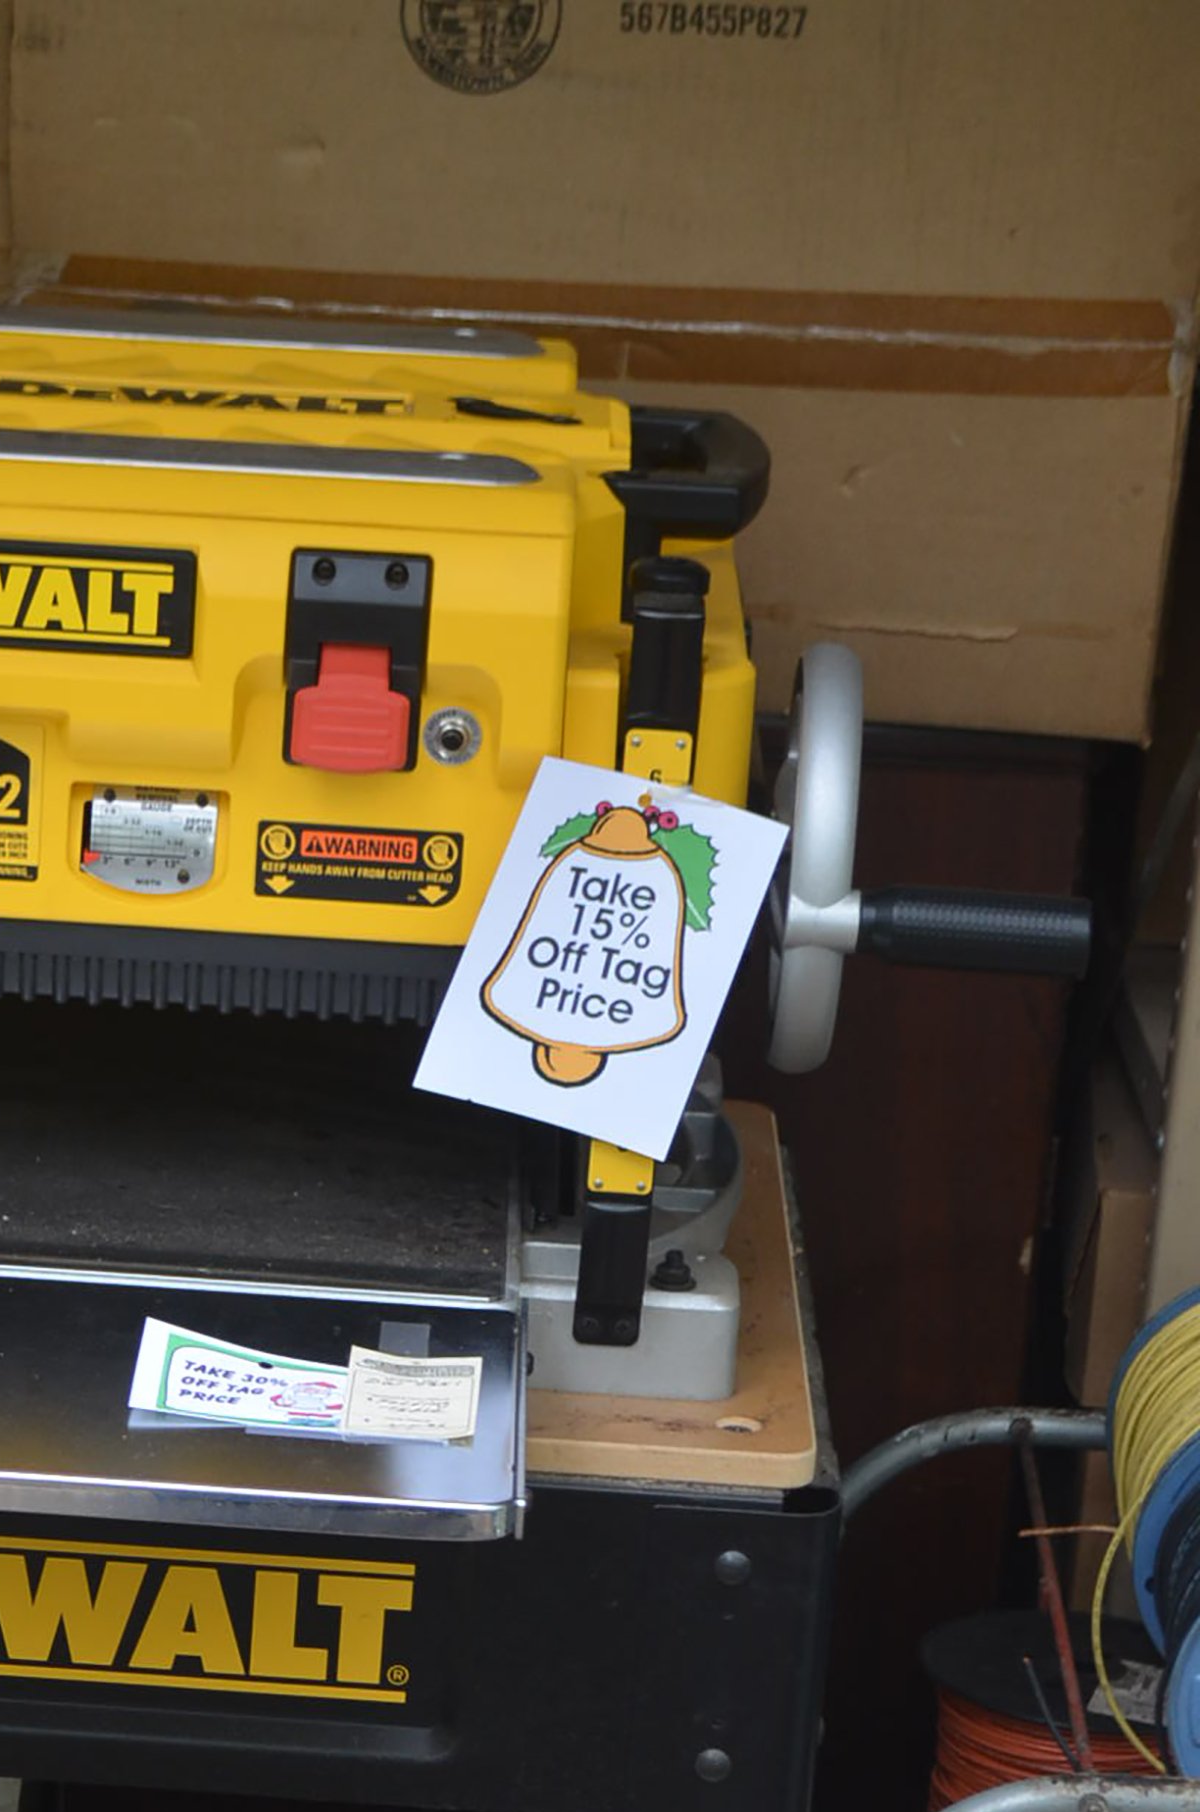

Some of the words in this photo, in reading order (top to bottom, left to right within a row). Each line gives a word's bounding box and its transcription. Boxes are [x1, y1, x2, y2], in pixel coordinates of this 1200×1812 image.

[323, 836, 414, 860] WARNING
[261, 861, 288, 873] KEEP
[288, 863, 324, 876] HANDS
[324, 865, 356, 878] AWAY
[357, 867, 386, 880] FROM
[386, 870, 424, 883] CUTTER
[425, 871, 455, 884] HEAD
[568, 866, 657, 912] Take
[571, 904, 651, 949] 15%
[527, 936, 589, 976] Off
[600, 947, 672, 999] Tag
[536, 977, 634, 1024] Price
[181, 1375, 220, 1389] OFF
[226, 1384, 265, 1395] TAG
[184, 1360, 237, 1379] TAKE
[241, 1373, 289, 1387] 30%
[178, 1388, 242, 1405] PRICE
